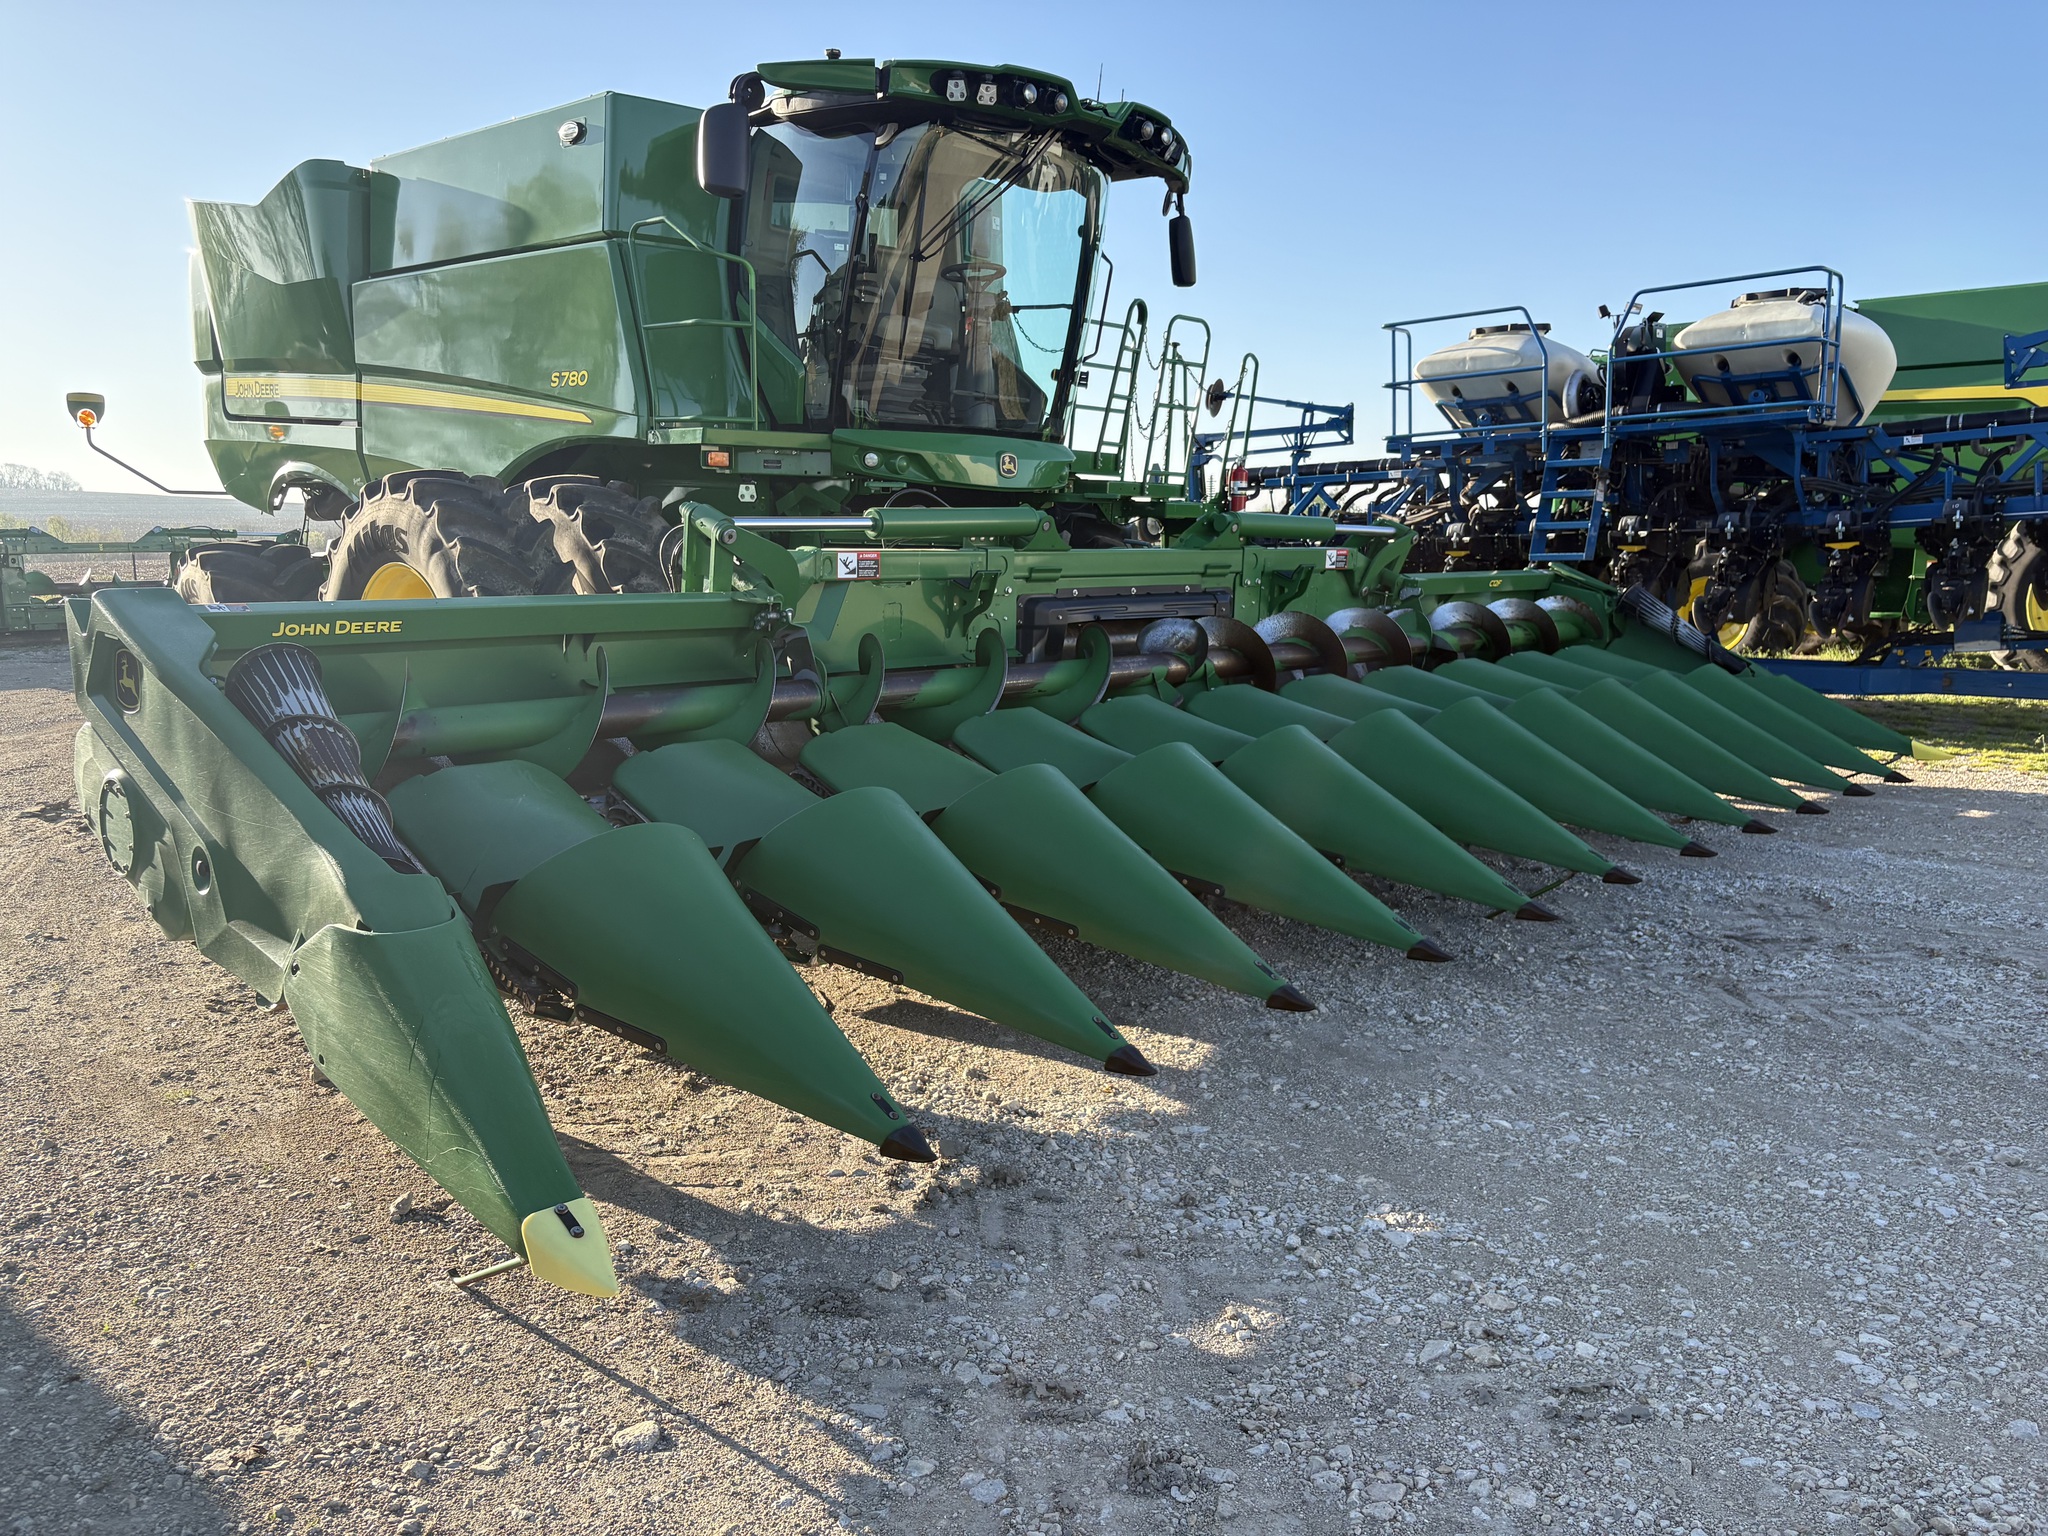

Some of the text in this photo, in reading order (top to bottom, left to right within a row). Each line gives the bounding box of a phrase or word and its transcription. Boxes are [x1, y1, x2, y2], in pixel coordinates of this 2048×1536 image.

[550, 370, 588, 388] S780
[235, 380, 280, 396] JOHN DEERE
[271, 620, 403, 637] JOHN DEERE
